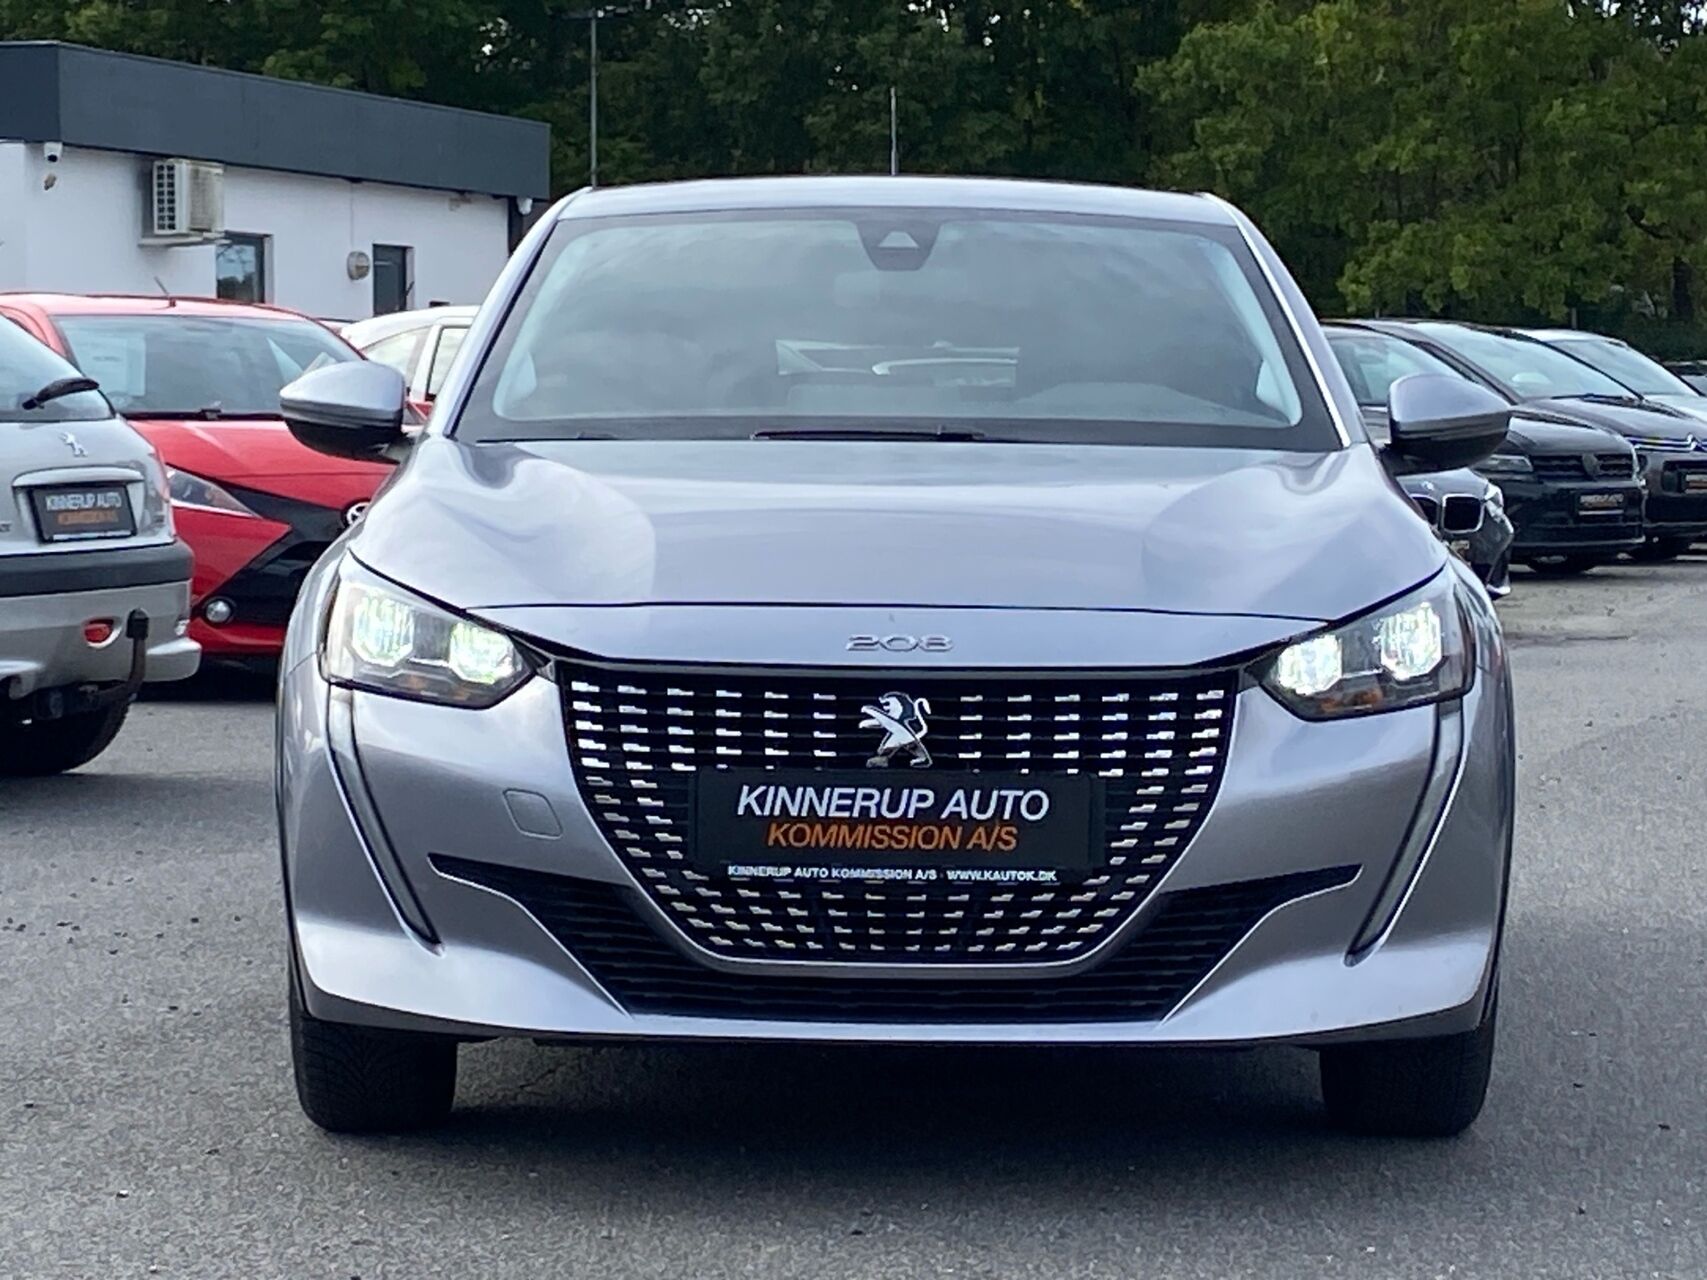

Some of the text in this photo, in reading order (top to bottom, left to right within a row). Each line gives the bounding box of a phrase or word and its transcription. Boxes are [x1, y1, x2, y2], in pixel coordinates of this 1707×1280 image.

[845, 634, 954, 652] 208
[737, 785, 1050, 821] KINNERUP AUTO
[768, 823, 1018, 850] KOMMISSION A/S
[728, 865, 1057, 881] KINNERUP AUTO KOMMISSION A/S WWW.KAUTOK.DK
